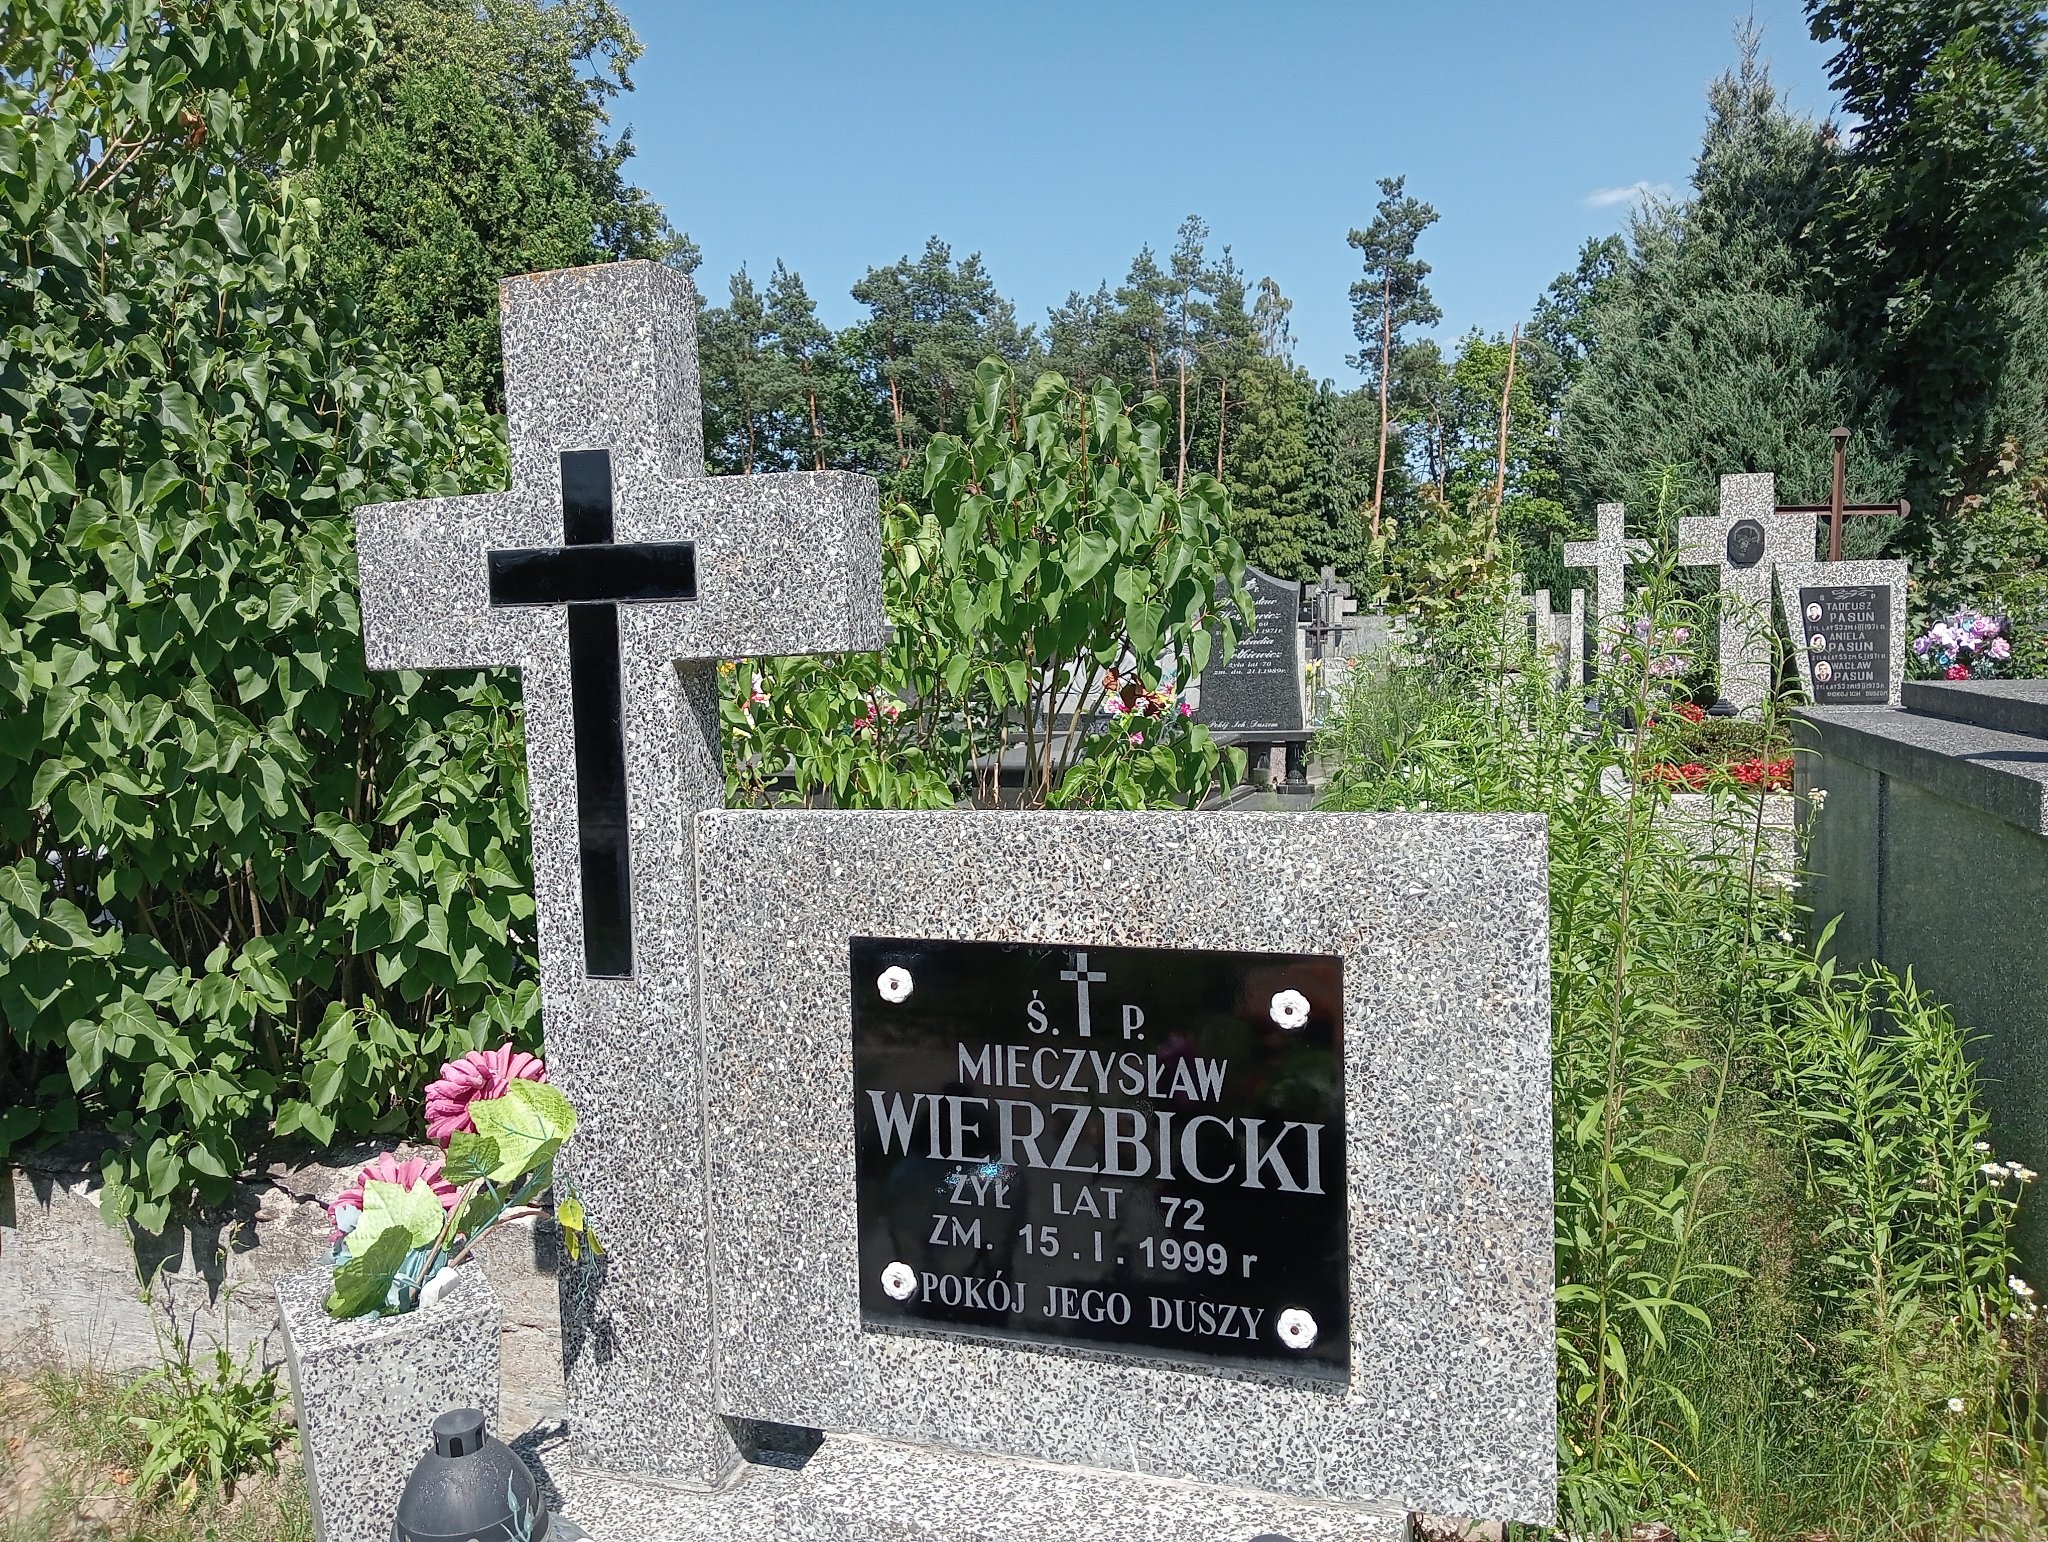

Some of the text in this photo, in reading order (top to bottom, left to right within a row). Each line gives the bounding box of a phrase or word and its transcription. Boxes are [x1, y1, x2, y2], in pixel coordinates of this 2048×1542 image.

[1826, 602, 1872, 611] TADEUSZ
[1830, 611, 1875, 623] PASUN
[1828, 641, 1874, 652] PASUN
[1829, 632, 1865, 640] ANIELA
[1831, 661, 1872, 670] WACŁAW
[1834, 671, 1874, 681] PASUN
[1122, 1004, 1145, 1041] P.
[958, 1042, 1228, 1103] MIECZYSŁAW
[865, 1089, 1326, 1195] WIERZBICKI
[950, 1164, 1205, 1231] ŻYŁ LAT 72
[929, 1214, 993, 1250] ZM.
[920, 1270, 1265, 1340] POKÓJ JEGO DUSZY
